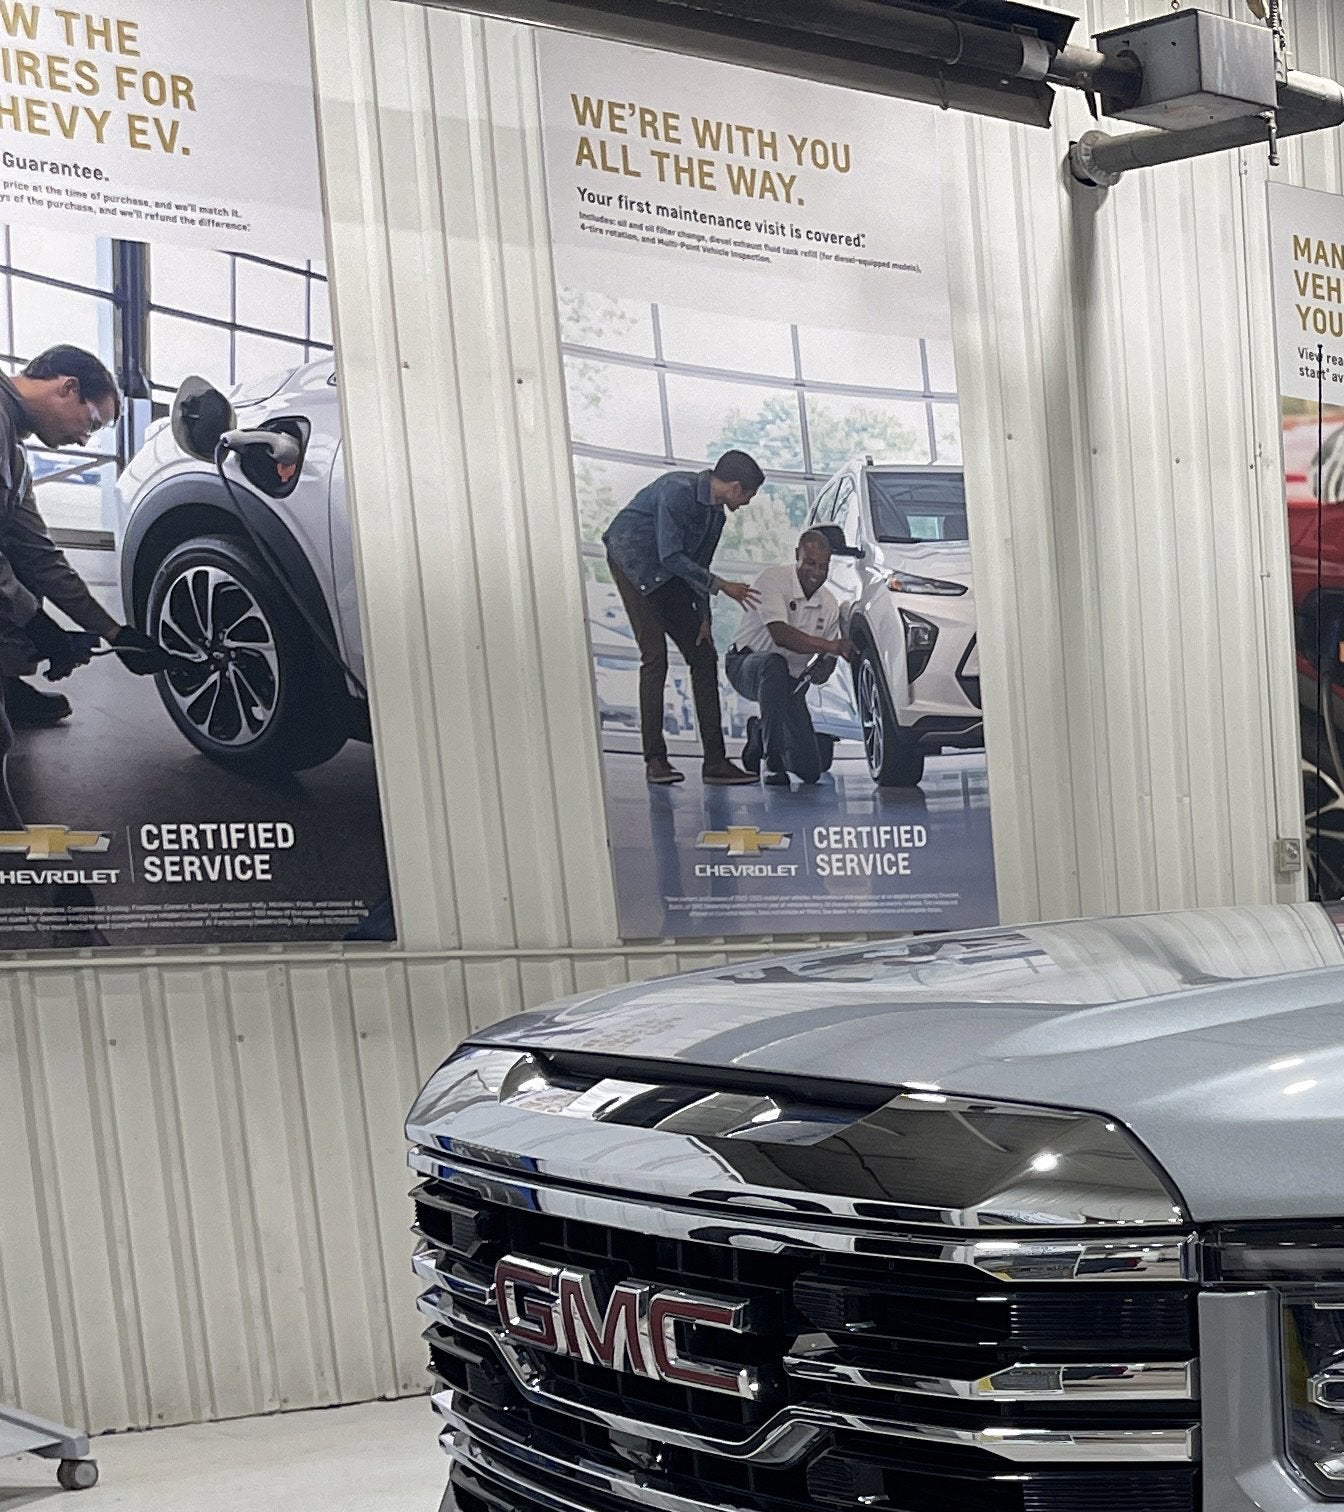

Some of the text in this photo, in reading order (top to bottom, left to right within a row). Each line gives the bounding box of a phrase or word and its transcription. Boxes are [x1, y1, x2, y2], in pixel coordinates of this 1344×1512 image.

[55, 9, 141, 57] THE
[2, 47, 197, 111] IRES FOR
[128, 113, 191, 156] EV.
[570, 93, 852, 173] WE'RE WITH YOU
[2, 151, 110, 182] Guarantee.
[575, 136, 805, 206] ALL THE WAY.
[3, 181, 29, 191] price
[46, 186, 62, 195] the
[65, 189, 88, 199] time
[90, 191, 101, 200] of
[154, 201, 172, 210] and
[199, 206, 229, 217] match
[231, 209, 242, 218] it.
[14, 194, 24, 203] of
[27, 196, 44, 206] the
[99, 206, 117, 216] and
[144, 211, 178, 224] refund
[179, 216, 196, 226] the
[577, 186, 612, 208] Your
[617, 194, 652, 215] first
[656, 203, 751, 233] maintenance
[755, 220, 785, 236] visit
[790, 224, 801, 238] is
[140, 822, 294, 851] CERTIFIED
[813, 825, 927, 849] CERTIFIED
[143, 854, 272, 882] SERVICE
[694, 863, 799, 878] CHEVROLET
[816, 852, 911, 876] SERVICE
[495, 1253, 757, 1401] GMC
